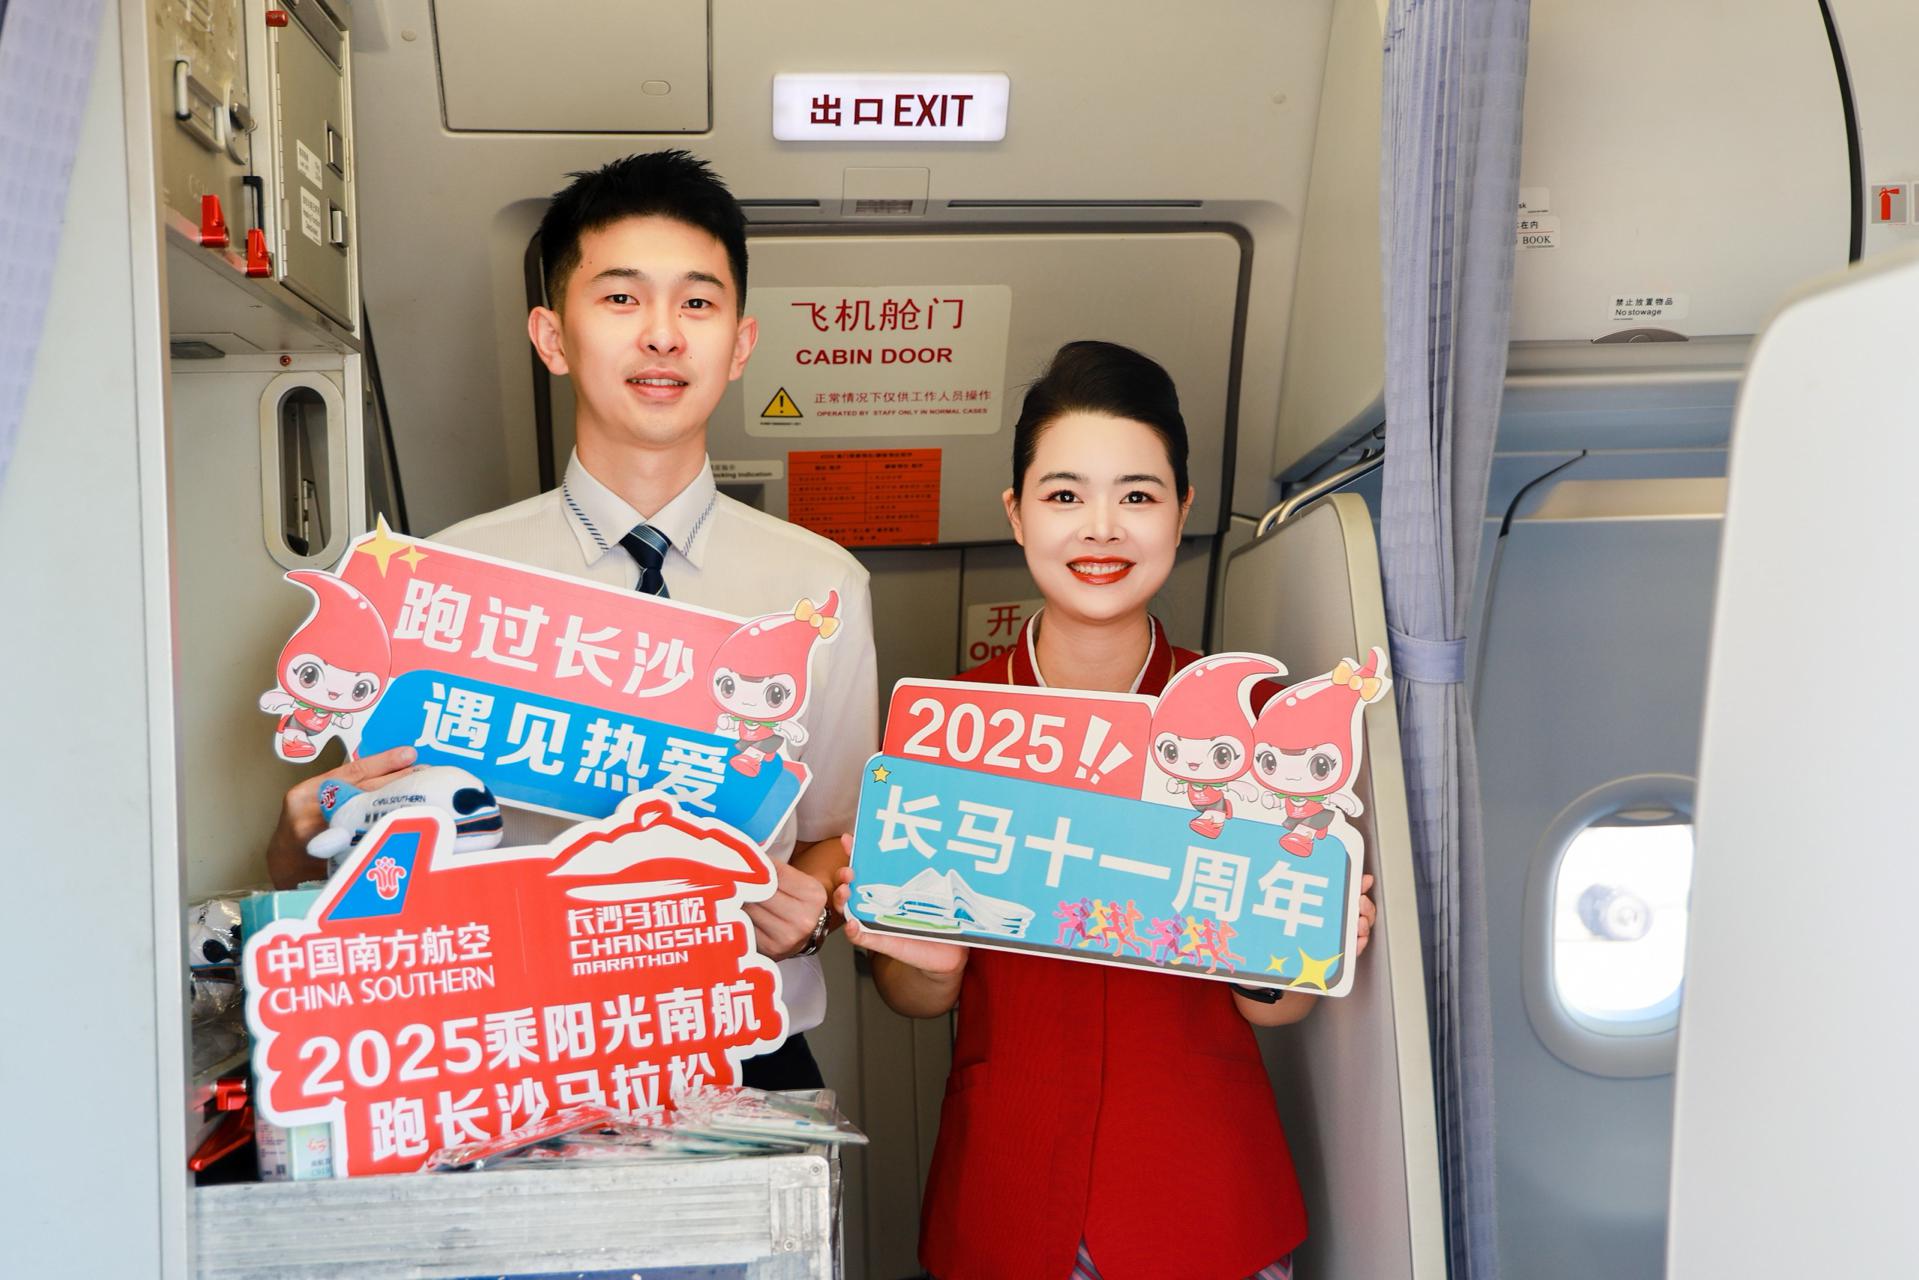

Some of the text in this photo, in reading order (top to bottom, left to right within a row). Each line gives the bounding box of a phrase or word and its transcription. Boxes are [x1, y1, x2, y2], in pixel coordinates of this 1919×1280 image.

[810, 94, 974, 127] 出口 EXIT
[1522, 235, 1552, 245] BOOK
[791, 298, 964, 333] 飞机舱门
[1616, 297, 1674, 306] 禁止放置物品
[1628, 308, 1662, 318] stowage
[796, 347, 953, 366] CABIN DOOR
[815, 390, 992, 404] 正常情况下仅供工作人员操作
[393, 577, 695, 699] 跑过长沙
[987, 604, 1021, 637] 开
[414, 682, 728, 813] 遇见热爱
[875, 783, 1330, 938] 长马十一周年
[567, 896, 707, 937] 长沙马拉松
[266, 921, 493, 983] 中国南方航空
[570, 923, 735, 960] CHANGSHA
[572, 950, 689, 976] MARATHON
[269, 964, 496, 1014] CHINA SOUTHERN
[299, 979, 762, 1097] 2025乘阳光南航
